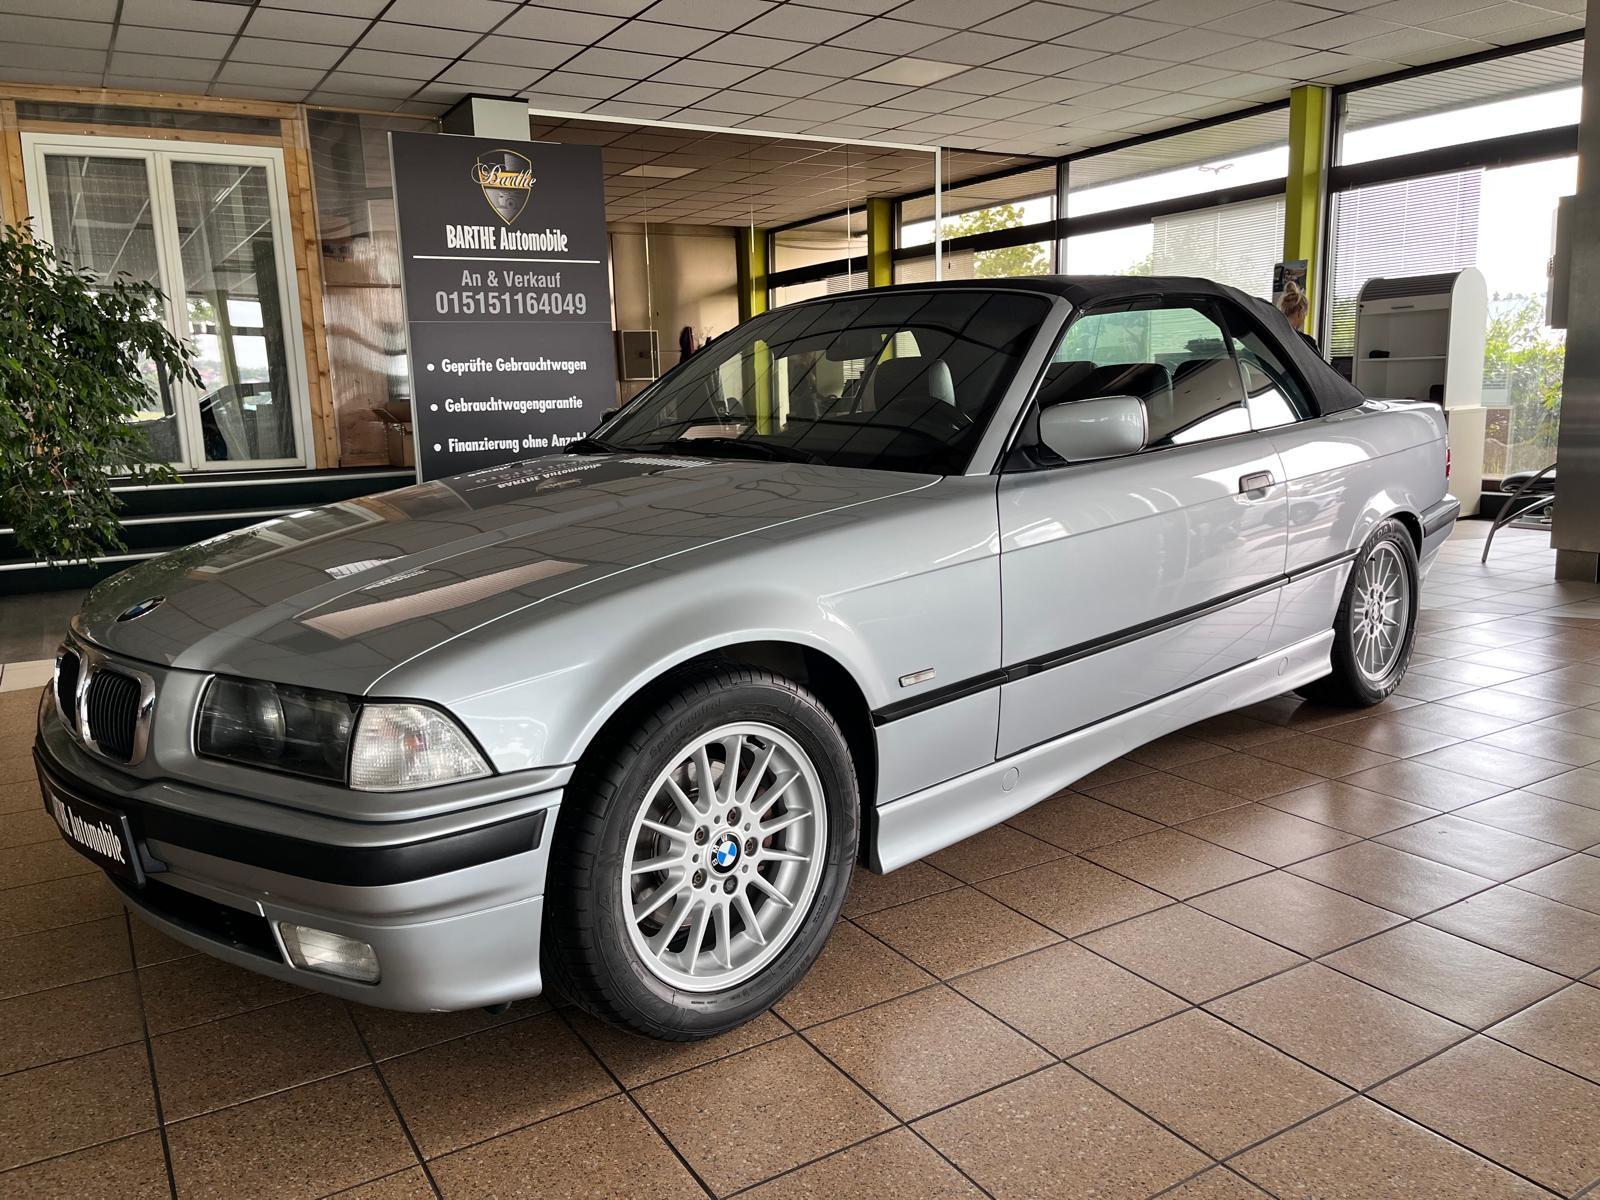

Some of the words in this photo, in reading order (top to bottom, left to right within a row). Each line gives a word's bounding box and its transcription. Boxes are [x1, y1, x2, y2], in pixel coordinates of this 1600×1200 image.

[471, 162, 537, 189] Barthe
[446, 224, 497, 250] BARTHE
[500, 226, 569, 252] Automobile
[461, 270, 482, 287] An
[487, 270, 499, 287] &
[503, 270, 561, 288] Verkauf
[435, 291, 587, 315] 015151164049
[441, 357, 493, 377] Geprüfte
[495, 356, 587, 375] Gebrauchtwagen
[445, 395, 583, 414] Gebrauchtwagengarantie
[448, 436, 520, 454] Finanzierung
[522, 434, 549, 449] ohne
[66, 805, 127, 865] Automobile
